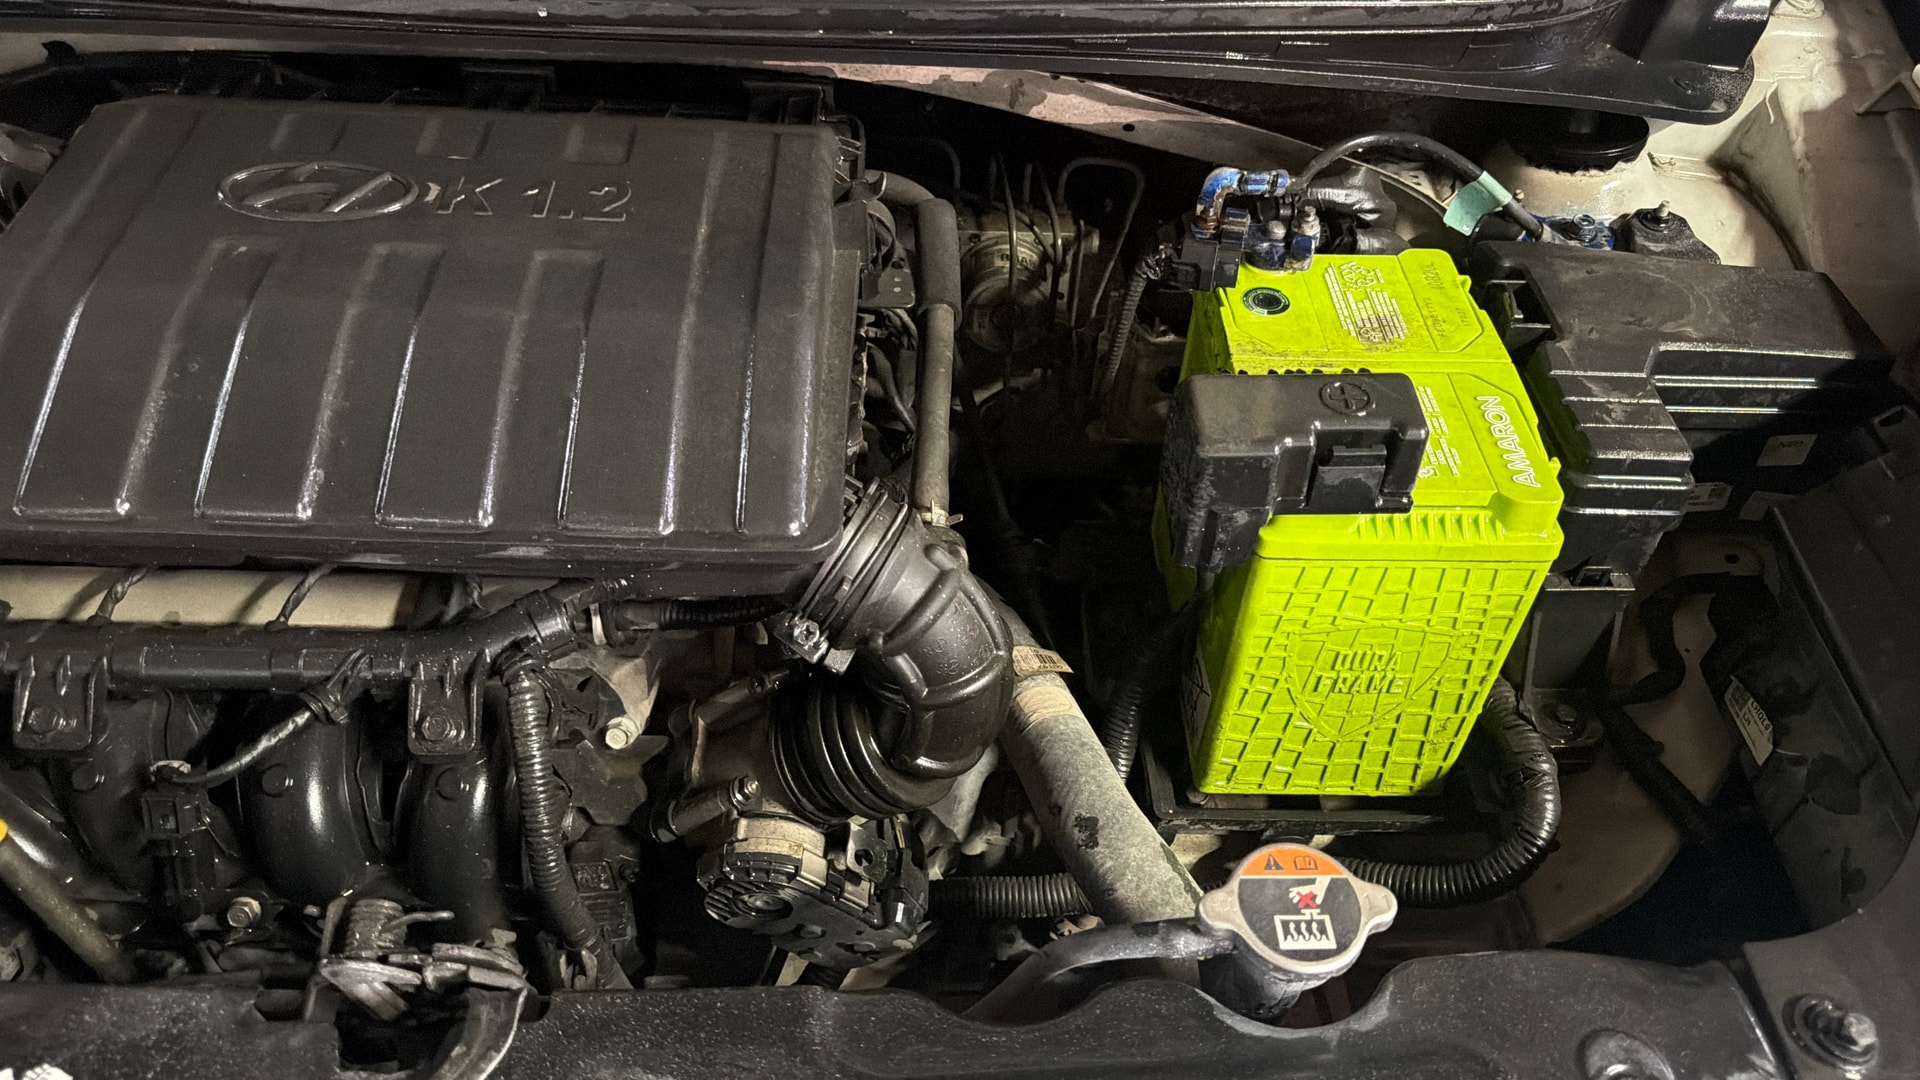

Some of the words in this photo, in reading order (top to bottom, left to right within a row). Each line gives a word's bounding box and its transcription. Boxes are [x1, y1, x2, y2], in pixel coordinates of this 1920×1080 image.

[522, 180, 633, 222] 1.2
[1476, 395, 1541, 489] AMARON
[1332, 649, 1402, 673] DURA
[1313, 671, 1410, 693] FRAME
